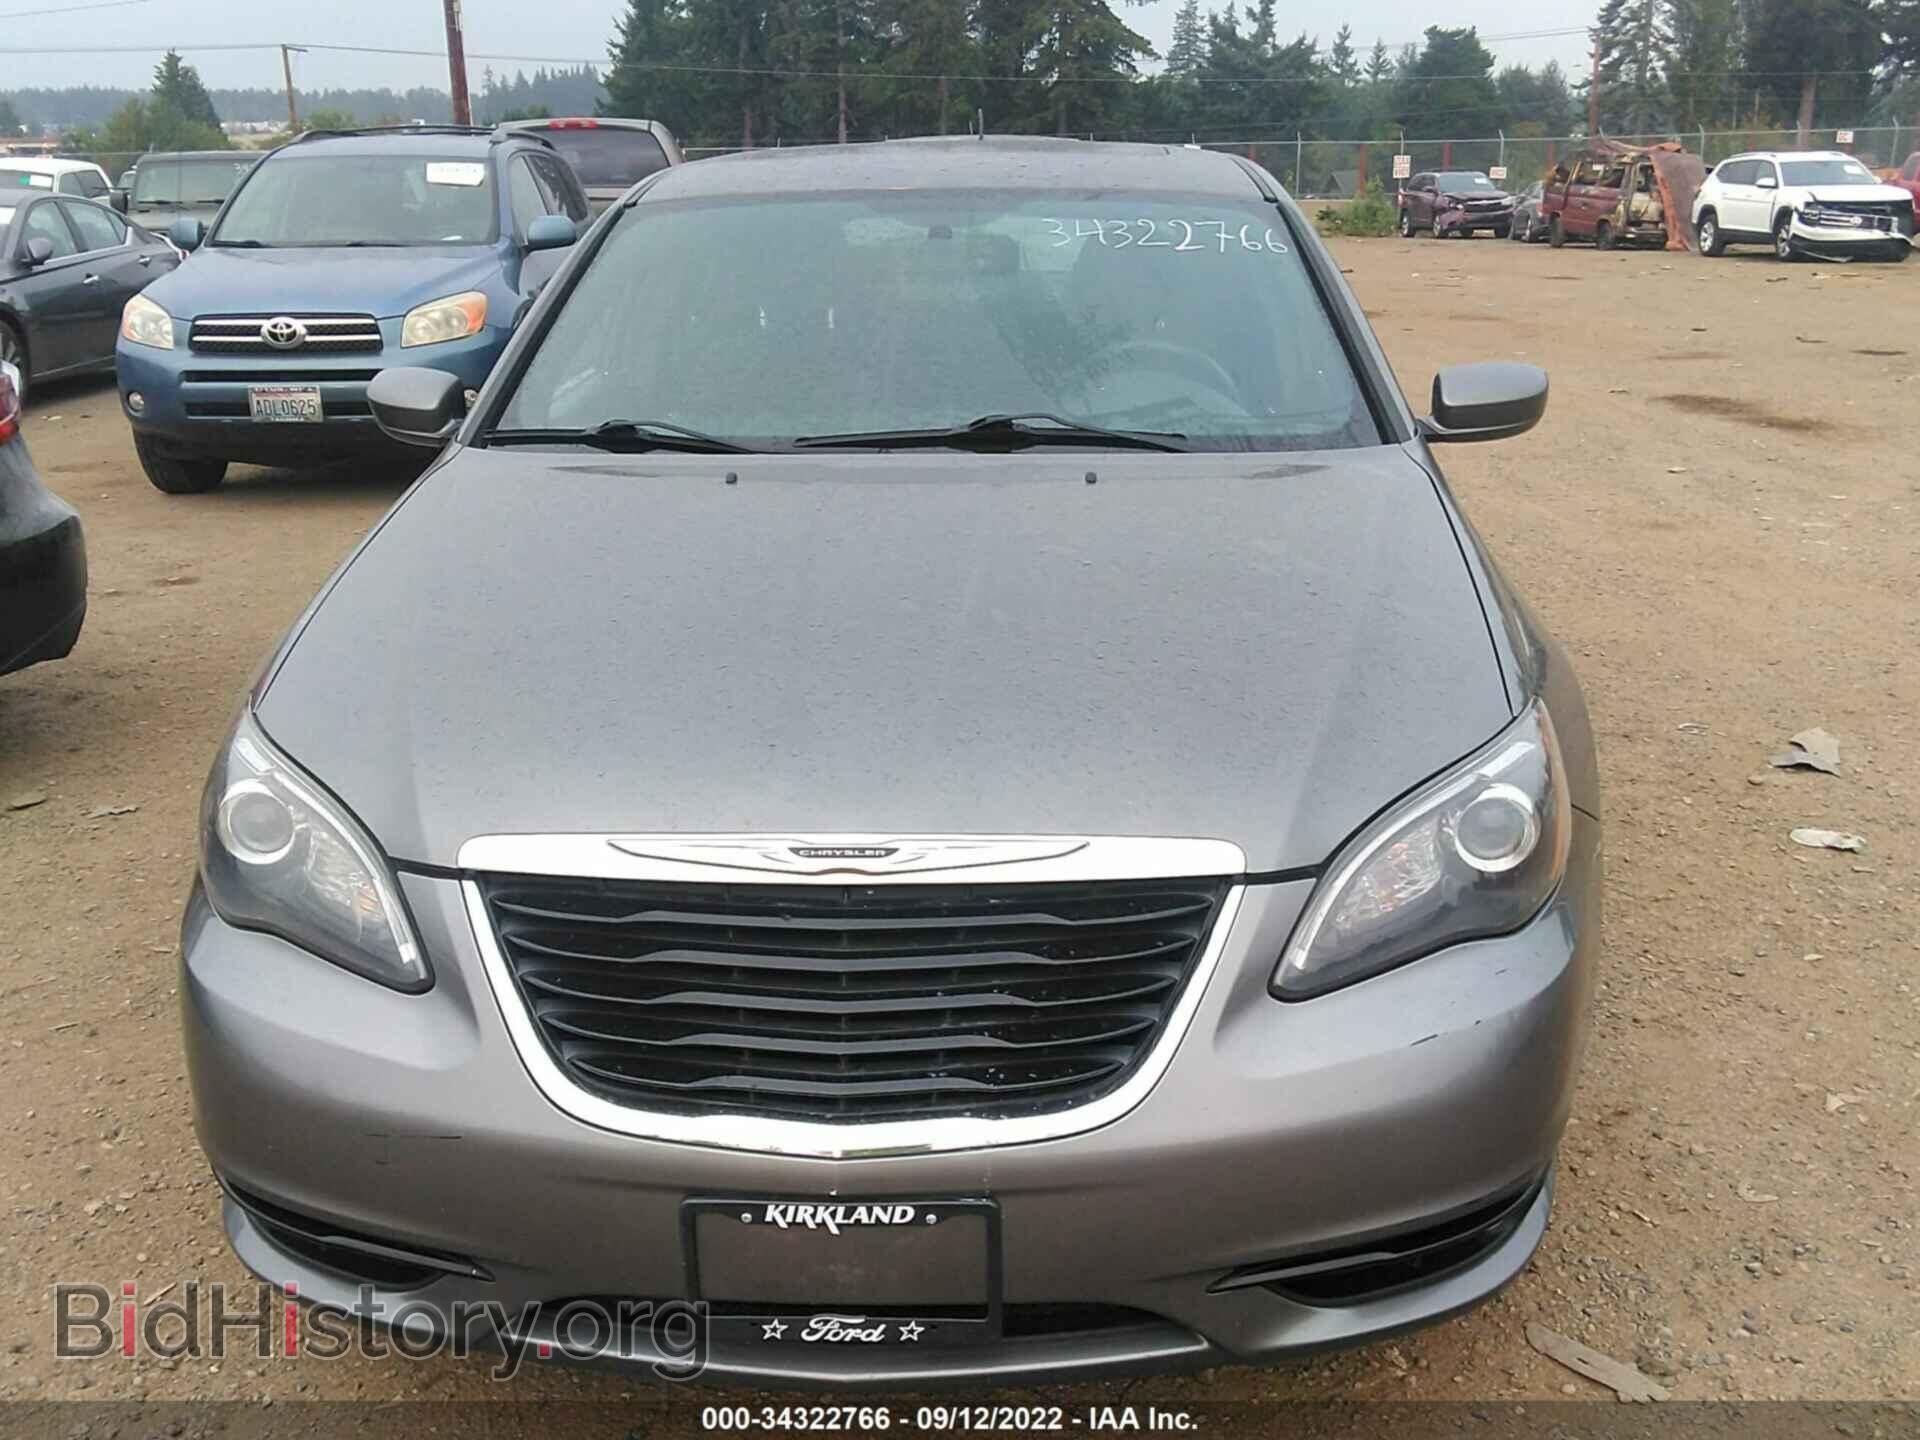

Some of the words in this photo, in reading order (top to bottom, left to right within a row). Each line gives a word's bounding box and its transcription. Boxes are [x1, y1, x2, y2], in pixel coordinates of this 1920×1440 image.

[1041, 217, 1289, 254] 34322766
[798, 848, 886, 857] CHRYSLER
[764, 1203, 916, 1236] KIRKLAND
[800, 1315, 888, 1343] Ford
